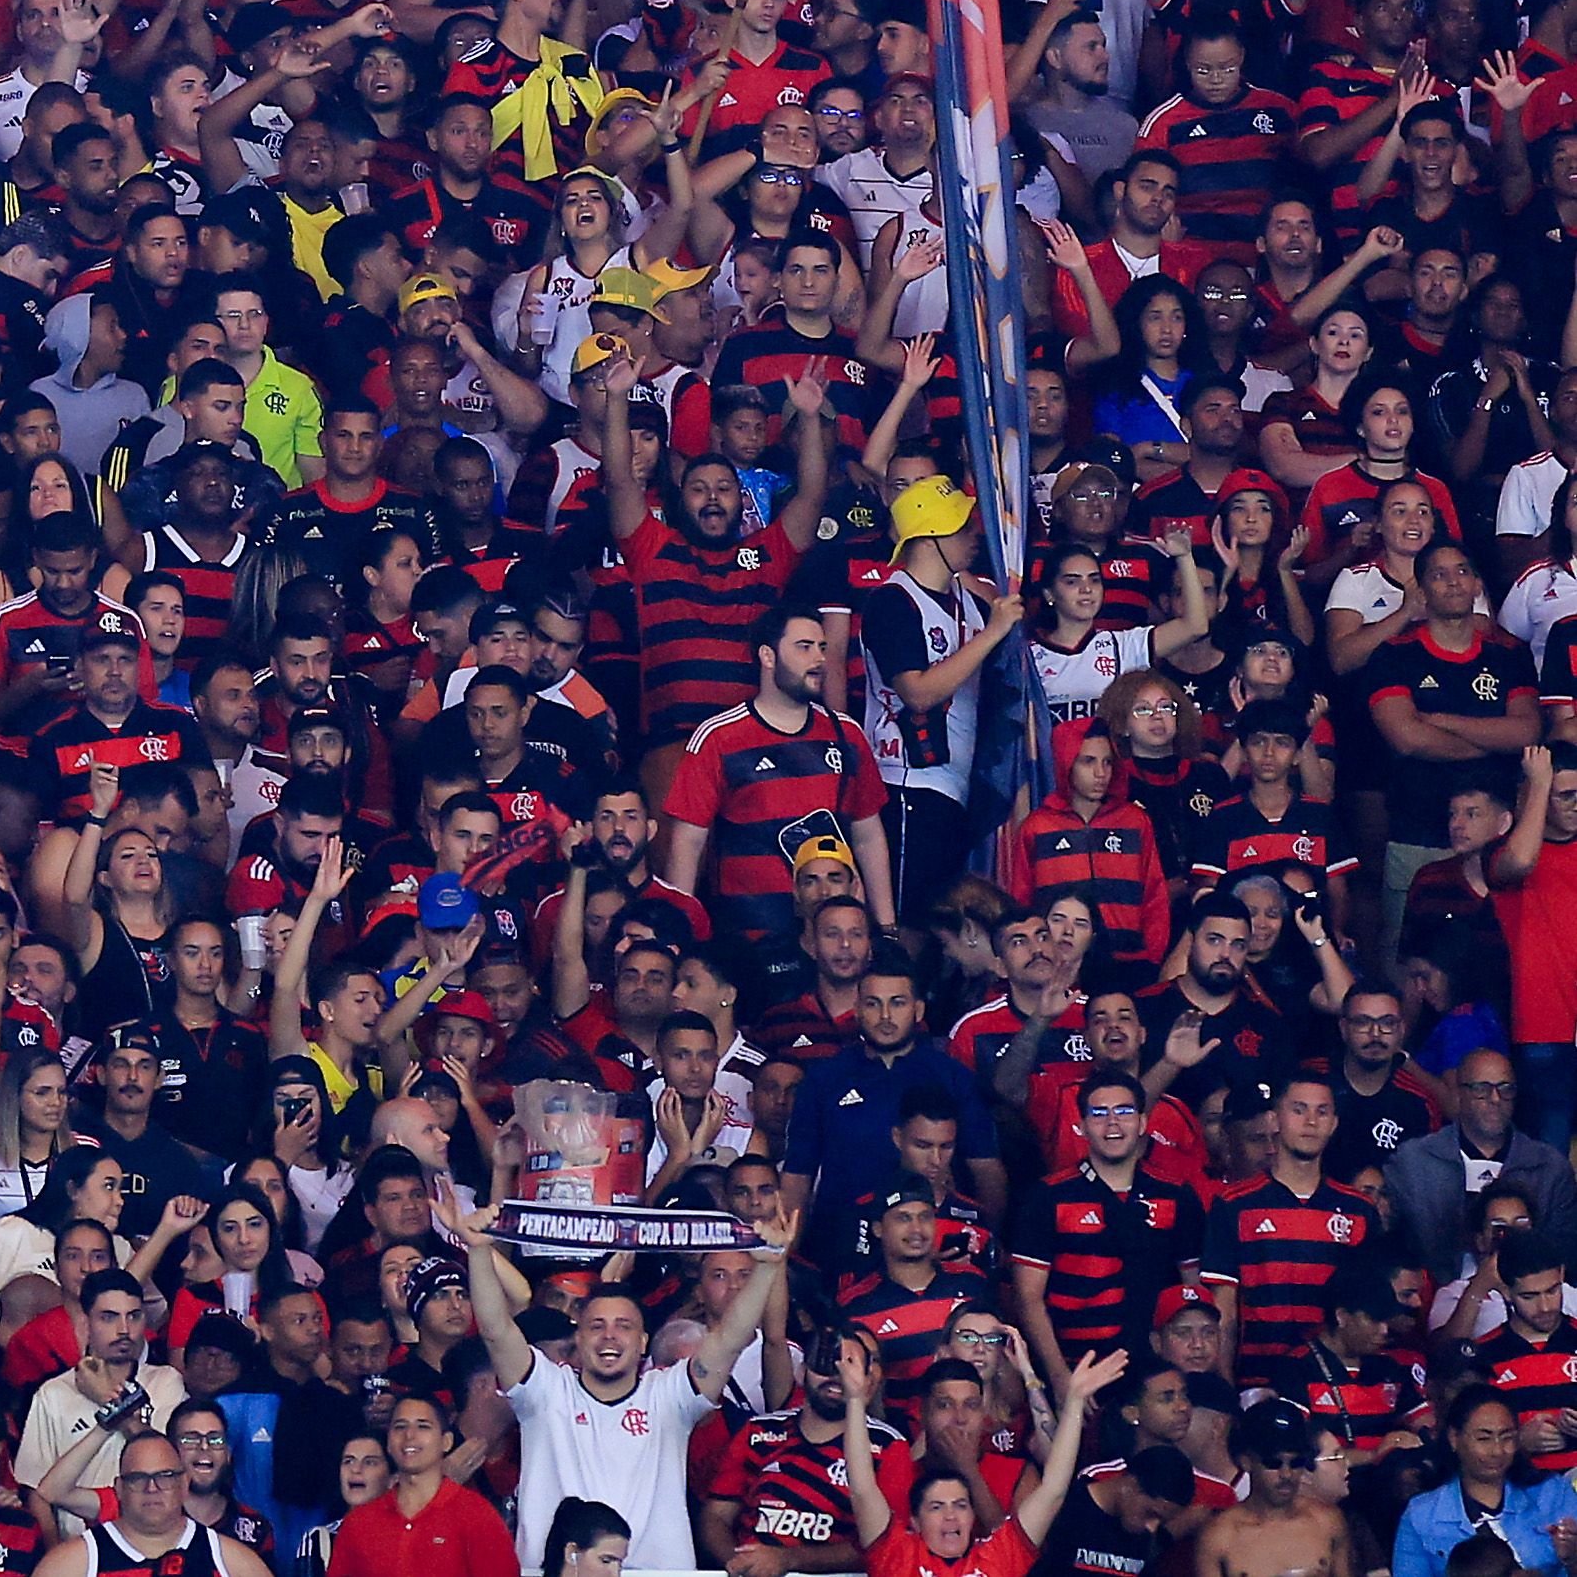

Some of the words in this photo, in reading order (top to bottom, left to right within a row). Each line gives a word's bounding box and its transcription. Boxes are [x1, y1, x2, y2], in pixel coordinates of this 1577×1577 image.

[517, 1212, 616, 1244] PENTACAMPEÃO
[638, 1221, 672, 1246] COPA
[672, 1221, 690, 1245] DO
[690, 1221, 736, 1245] BRASIL
[773, 1508, 835, 1541] BRB
